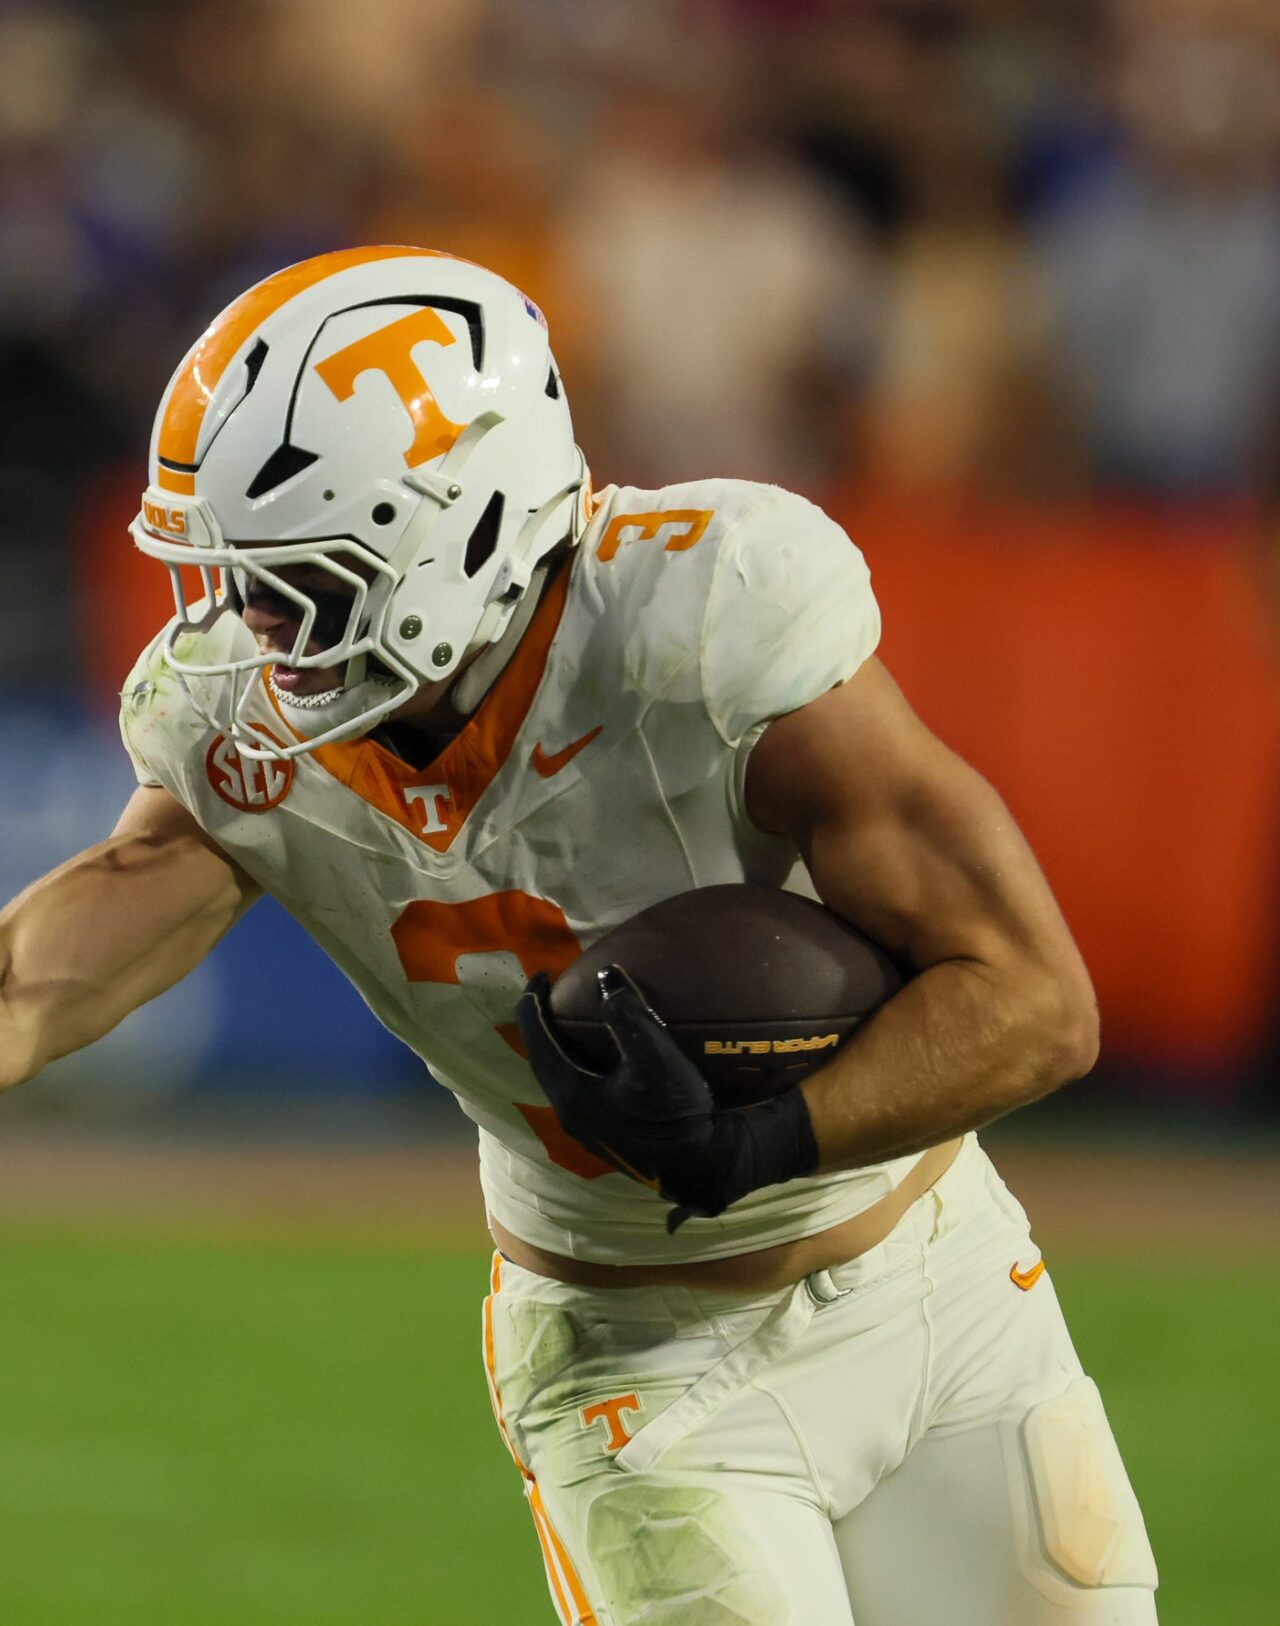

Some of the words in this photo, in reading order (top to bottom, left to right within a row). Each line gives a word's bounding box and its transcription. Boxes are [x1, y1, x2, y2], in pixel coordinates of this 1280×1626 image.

[314, 306, 470, 470] T
[143, 500, 185, 535] VOLS
[596, 508, 716, 563] 3
[213, 727, 287, 805] SEC
[403, 783, 451, 835] T
[704, 1040, 771, 1055] ELITE
[772, 1033, 840, 1053] VAPOR
[580, 1390, 642, 1453] T
